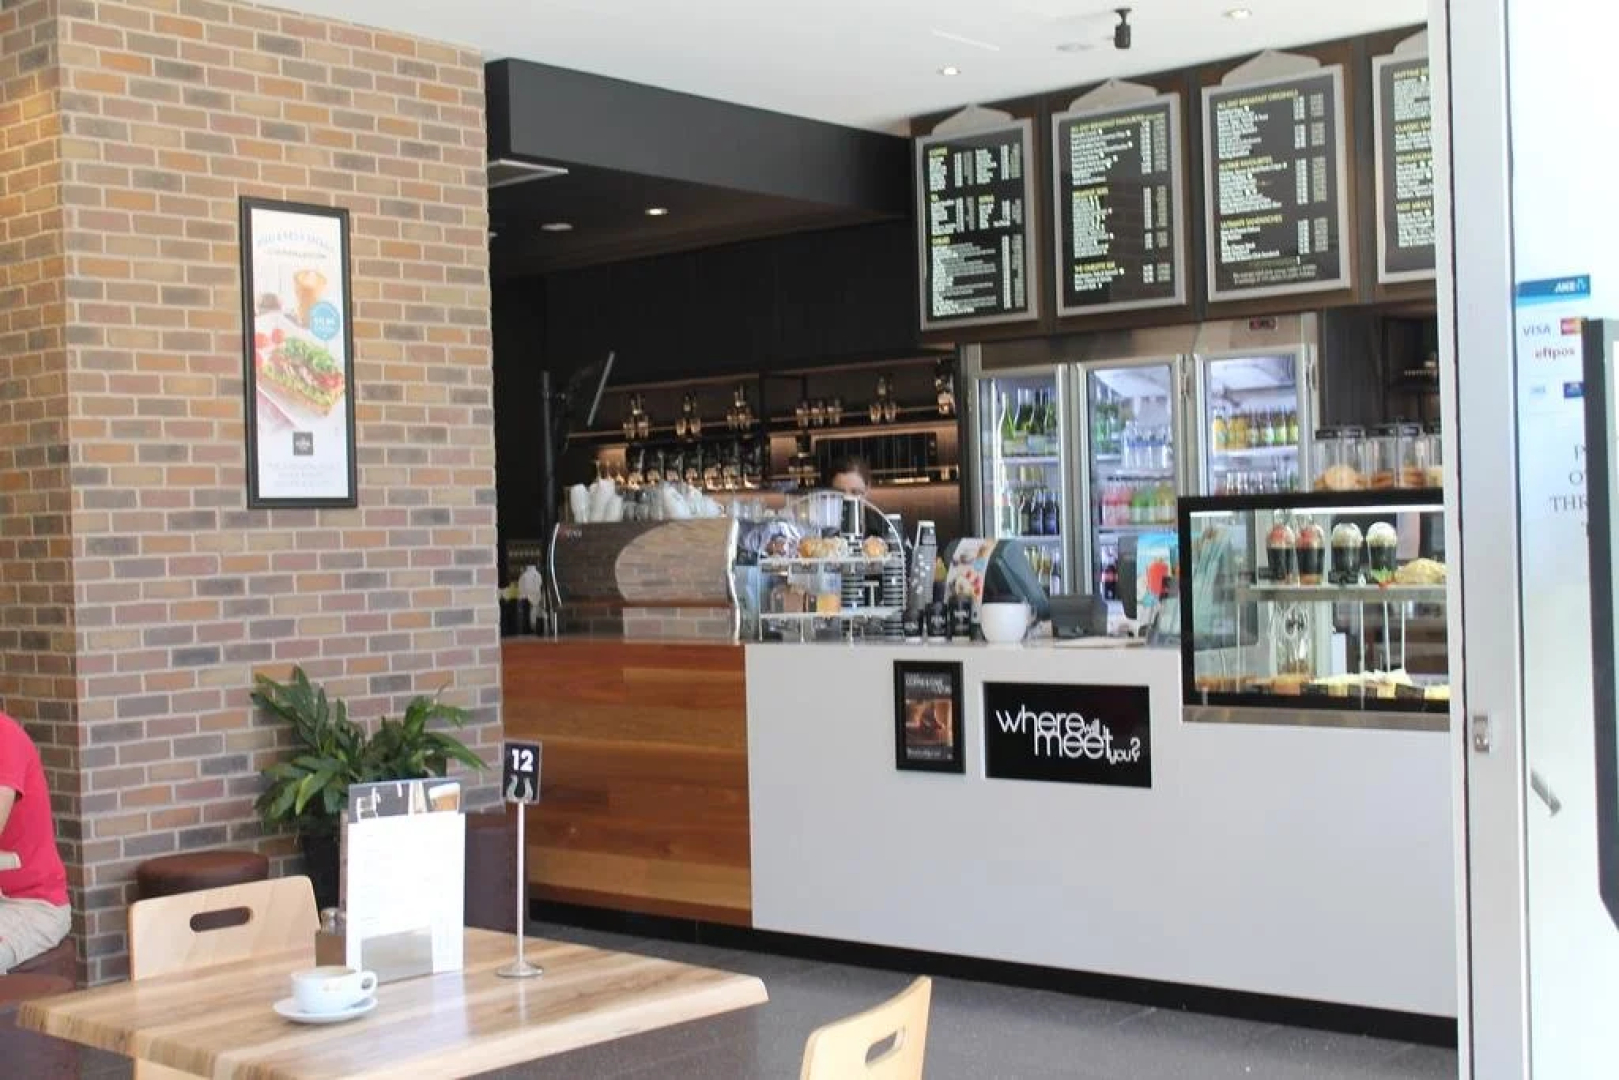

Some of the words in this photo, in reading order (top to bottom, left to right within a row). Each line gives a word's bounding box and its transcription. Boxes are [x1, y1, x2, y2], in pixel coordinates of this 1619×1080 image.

[1523, 324, 1550, 337] VISA
[1534, 347, 1575, 360] eftpos
[995, 704, 1085, 734] where
[1033, 728, 1113, 760] meet
[511, 747, 534, 772] 12
